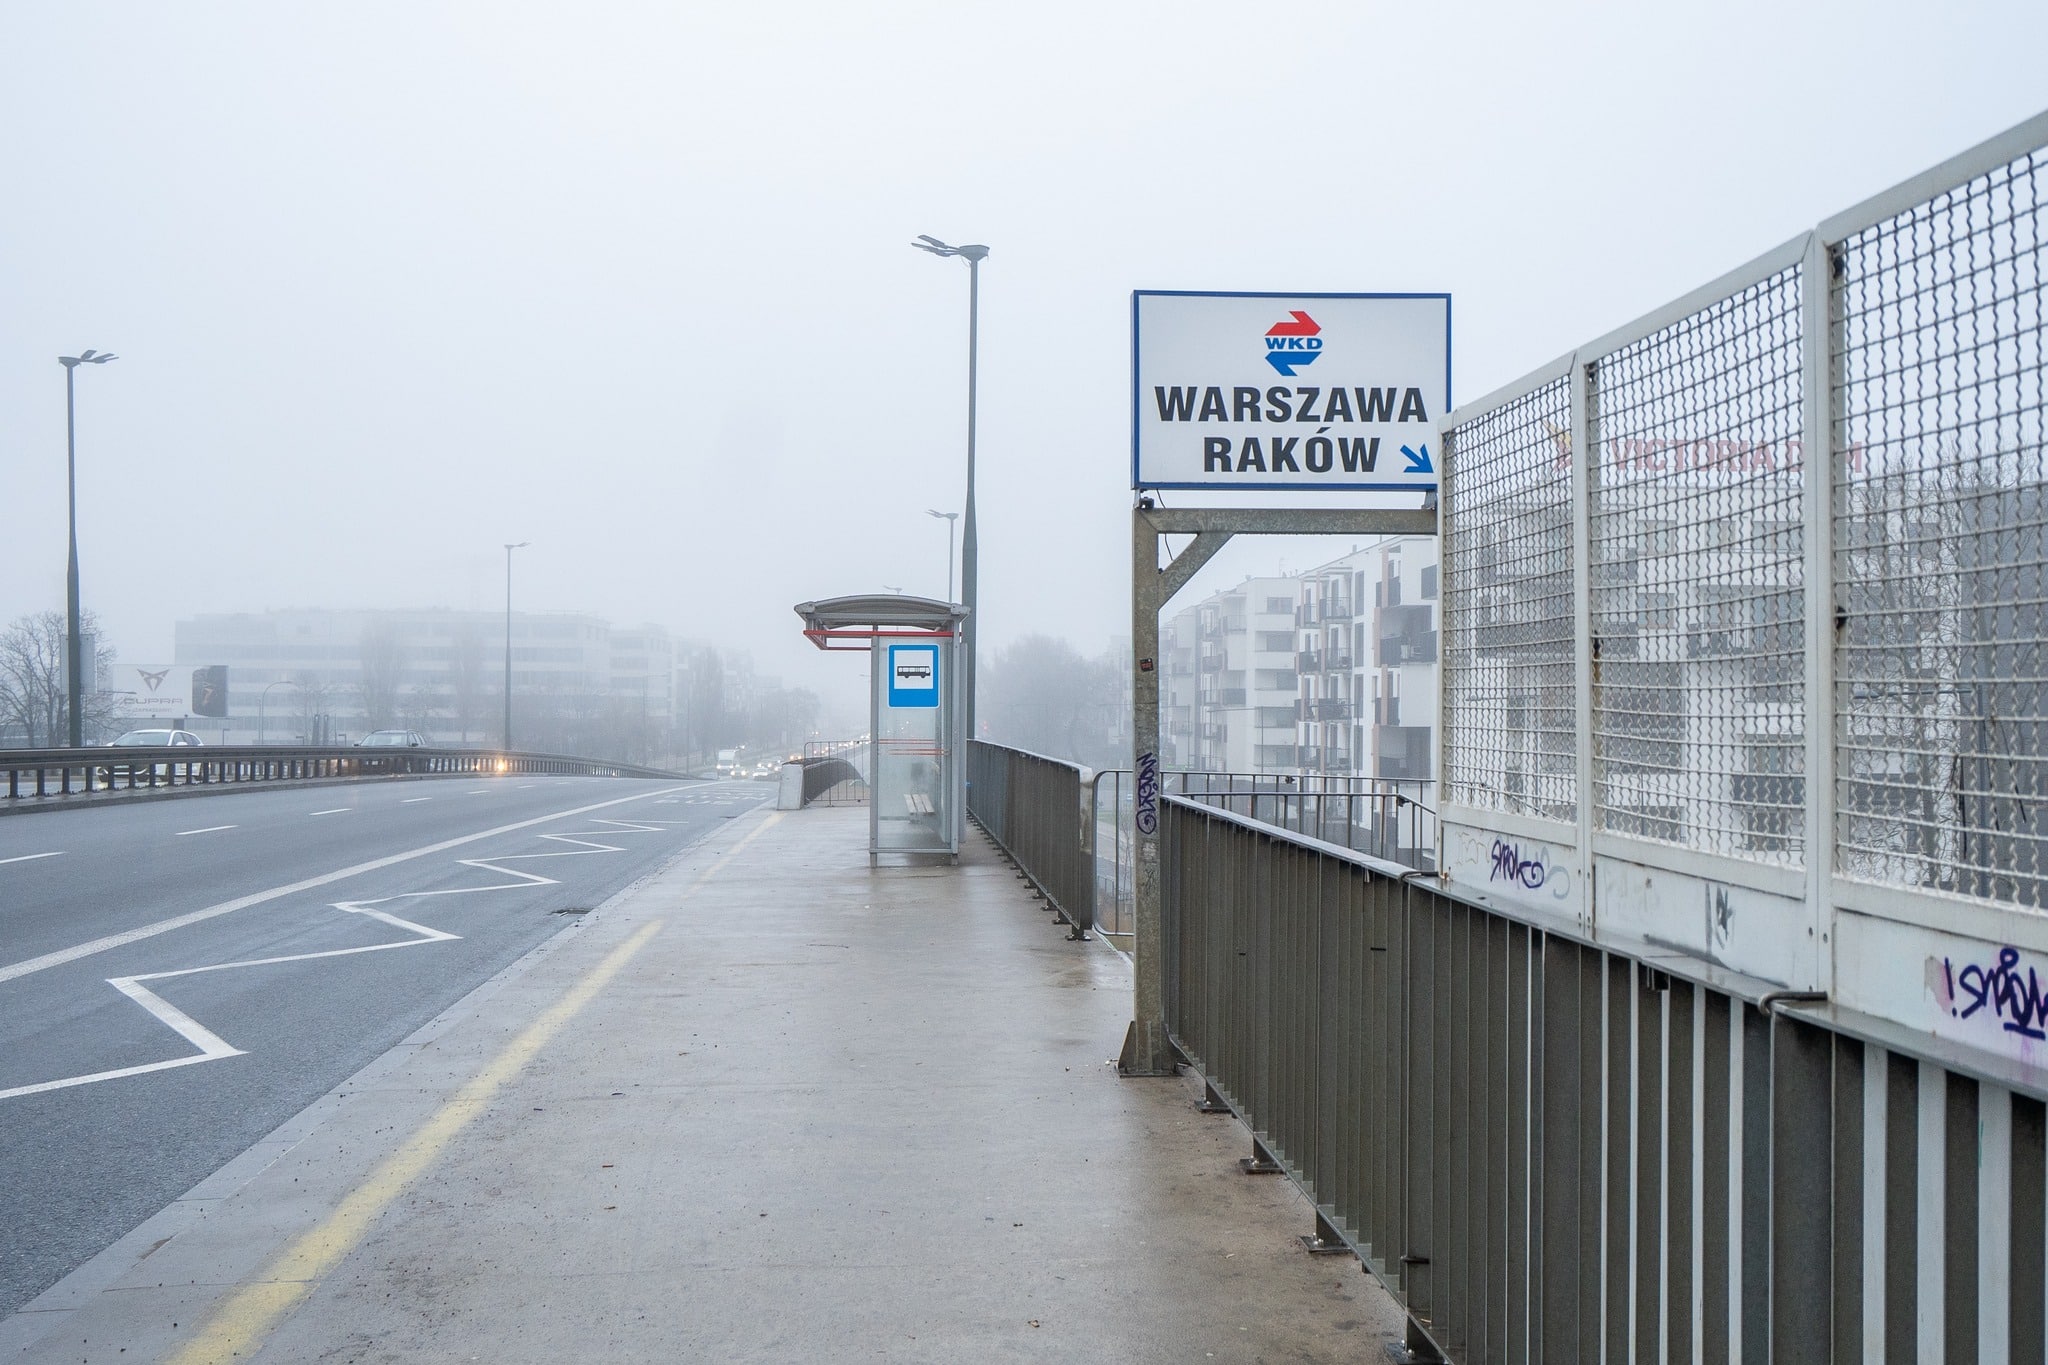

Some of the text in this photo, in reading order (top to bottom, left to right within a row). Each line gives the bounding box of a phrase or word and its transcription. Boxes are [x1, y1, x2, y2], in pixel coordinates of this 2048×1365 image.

[1264, 337, 1323, 350] WKD
[1154, 386, 1429, 423] WARSZAWA
[1203, 426, 1381, 474] RAKÓW
[1610, 438, 1775, 473] VICTORIA
